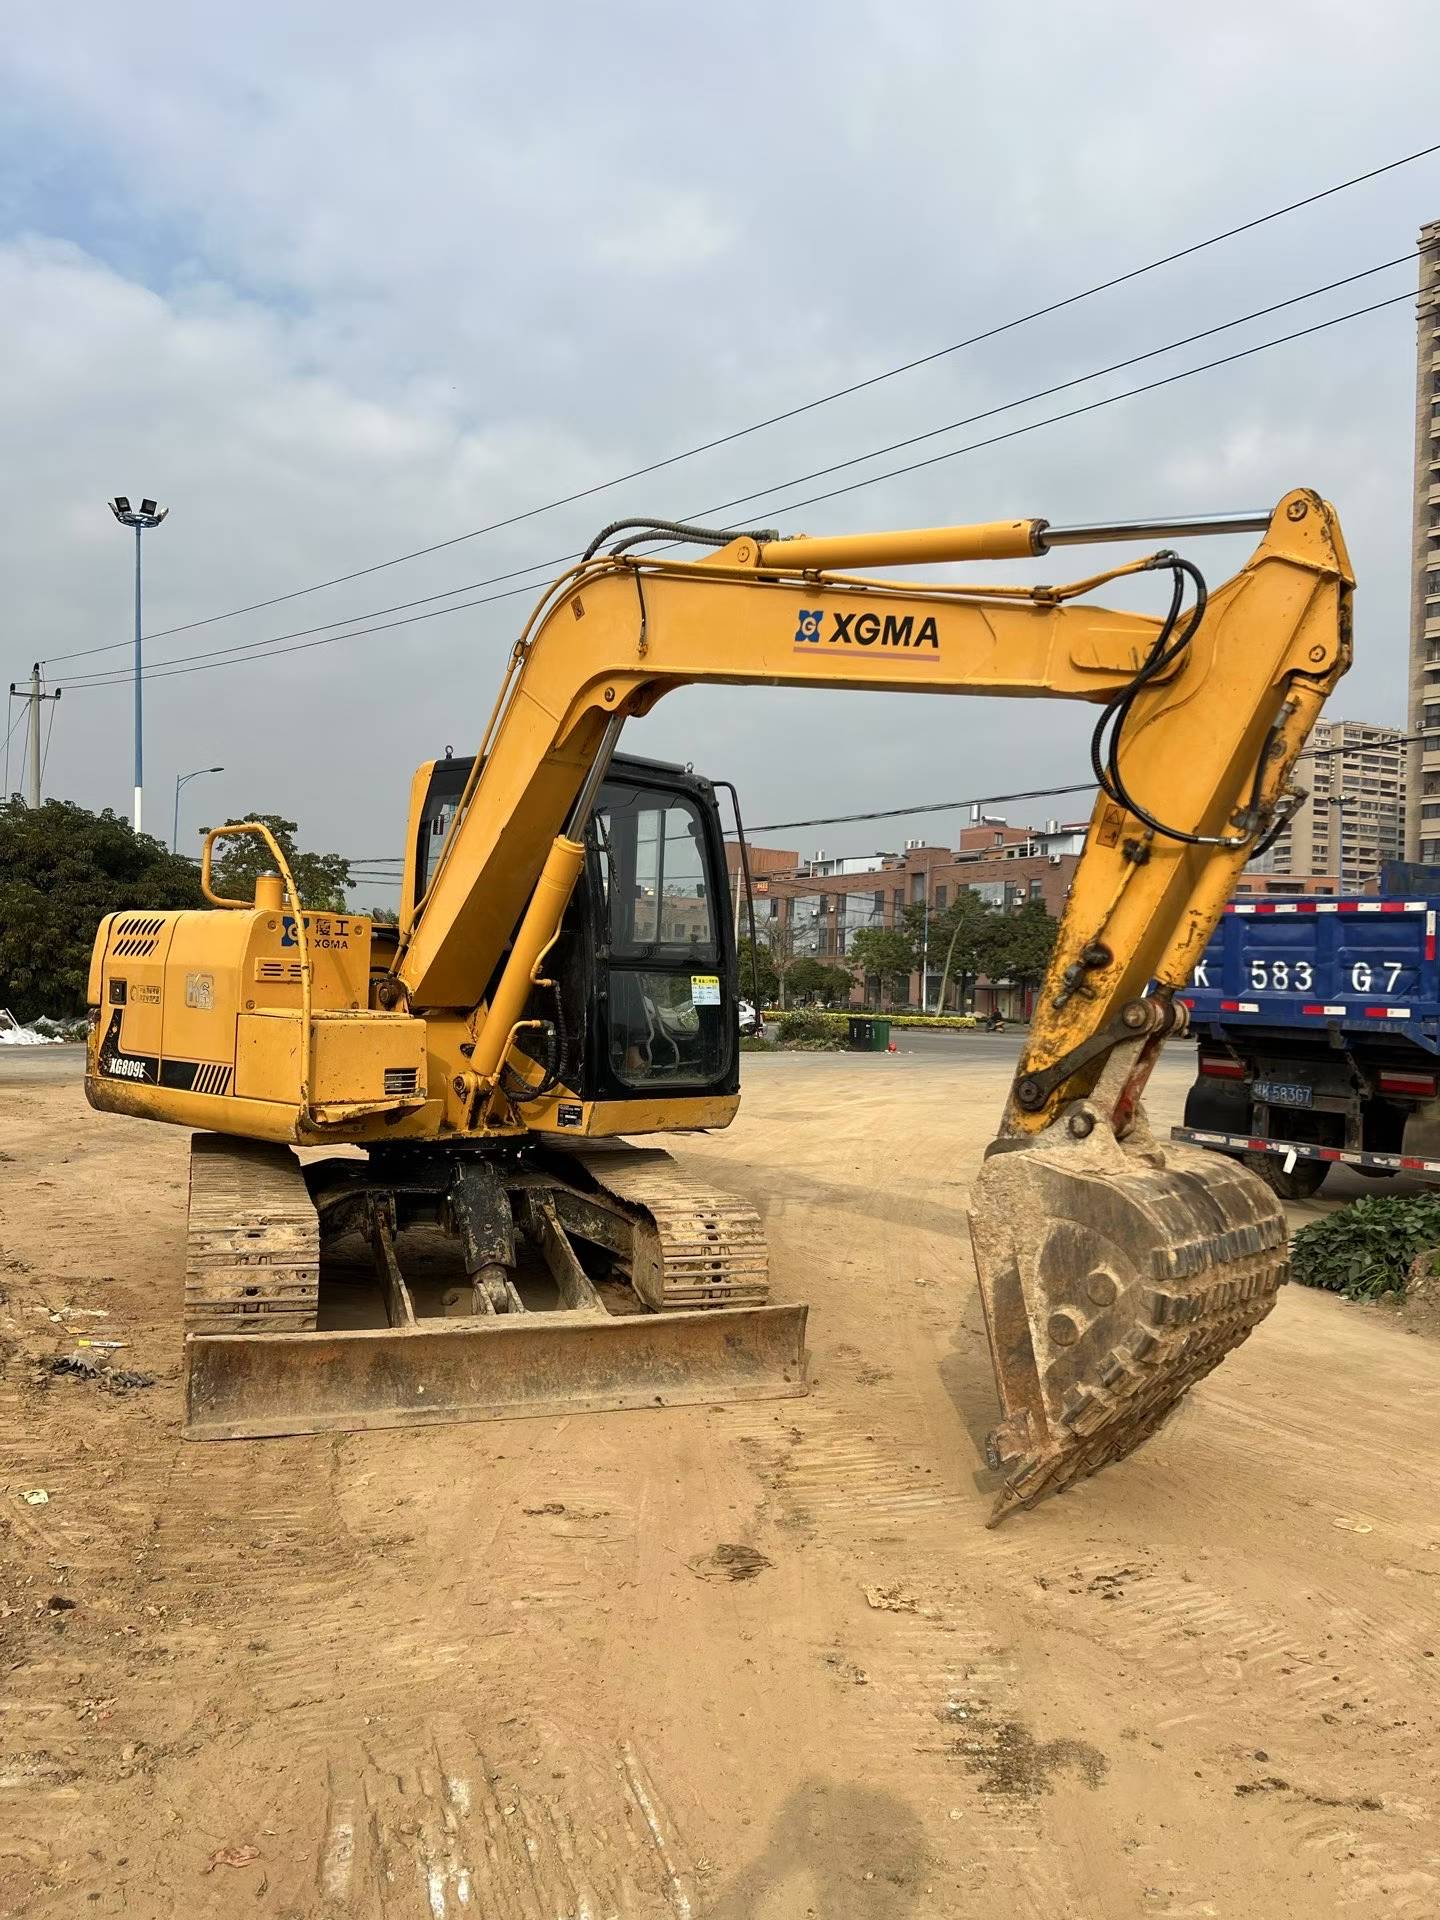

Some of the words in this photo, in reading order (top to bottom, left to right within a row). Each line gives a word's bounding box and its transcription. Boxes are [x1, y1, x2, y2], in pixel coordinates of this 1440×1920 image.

[829, 613, 940, 649] XGMA
[315, 939, 348, 949] XGMA
[1251, 960, 1313, 991] 583
[110, 1058, 146, 1078] XG809E
